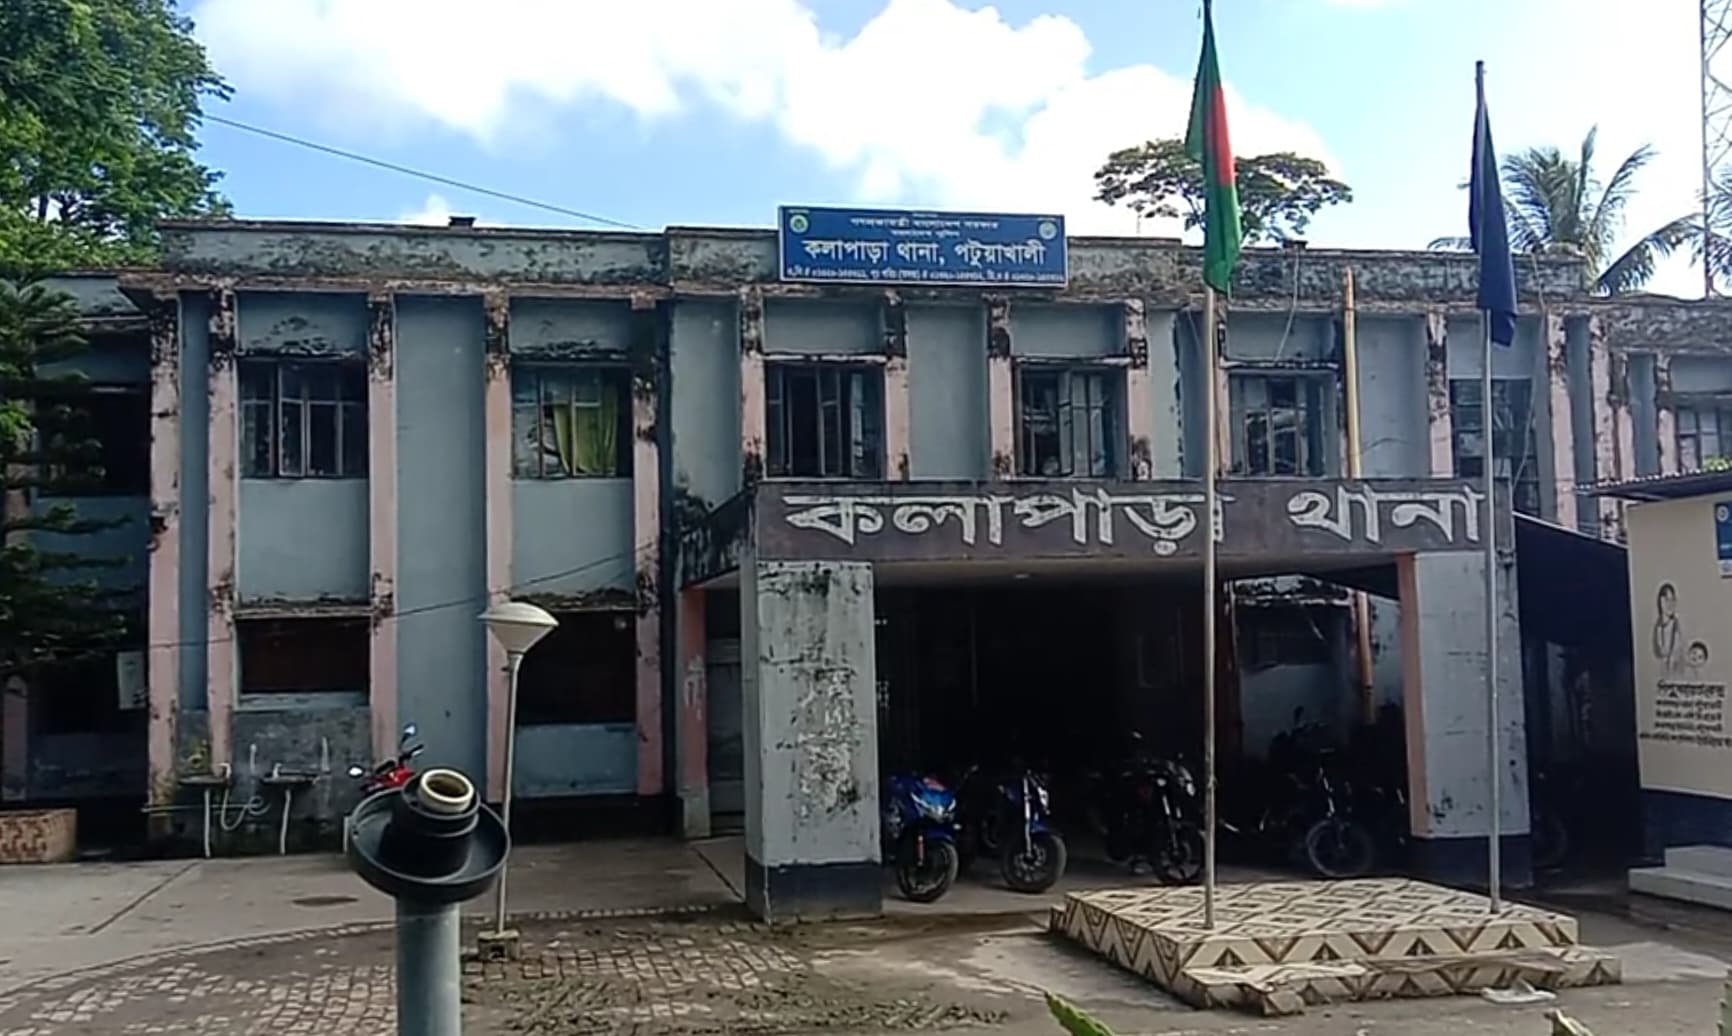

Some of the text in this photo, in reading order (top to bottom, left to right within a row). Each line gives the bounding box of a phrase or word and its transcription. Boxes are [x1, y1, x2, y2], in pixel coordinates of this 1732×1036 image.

[801, 240, 890, 264] কলাপাড়া
[896, 242, 945, 266] থানা,
[782, 485, 1485, 556] কলাপাড়া থানা
